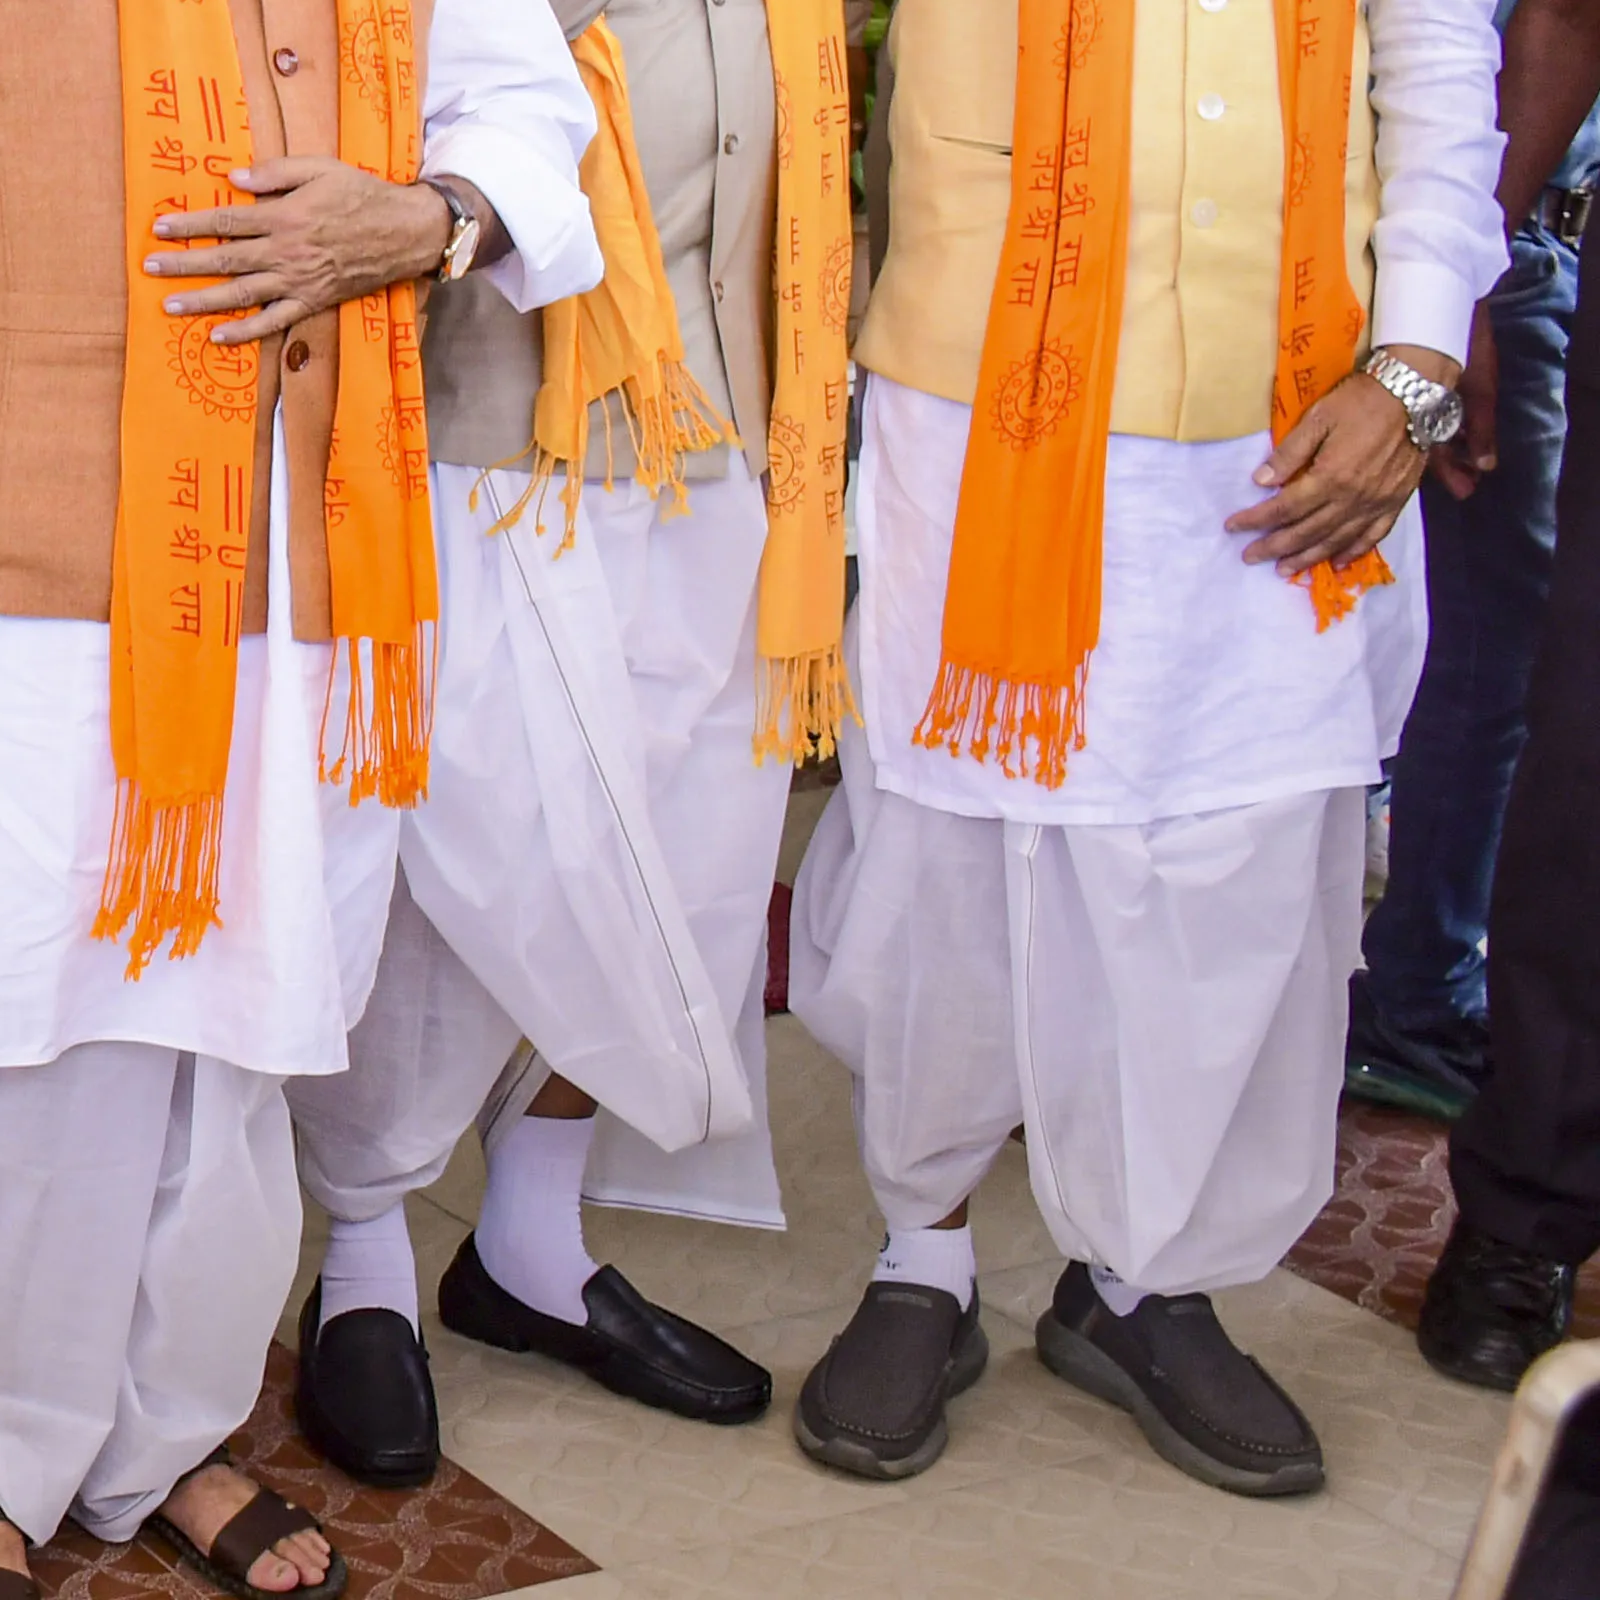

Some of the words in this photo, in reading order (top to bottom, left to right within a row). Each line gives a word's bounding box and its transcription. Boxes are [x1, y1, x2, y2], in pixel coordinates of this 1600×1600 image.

[144, 68, 180, 124] जय
[150, 135, 198, 176] श्री
[1064, 116, 1092, 171] जय
[1028, 146, 1058, 195] जय
[1020, 204, 1054, 240] श्री
[1059, 182, 1096, 220] श्री
[1007, 257, 1041, 307] राम
[1053, 233, 1083, 290] राम
[167, 458, 199, 512] जय
[170, 523, 212, 564] श्री
[170, 581, 200, 638] राम
